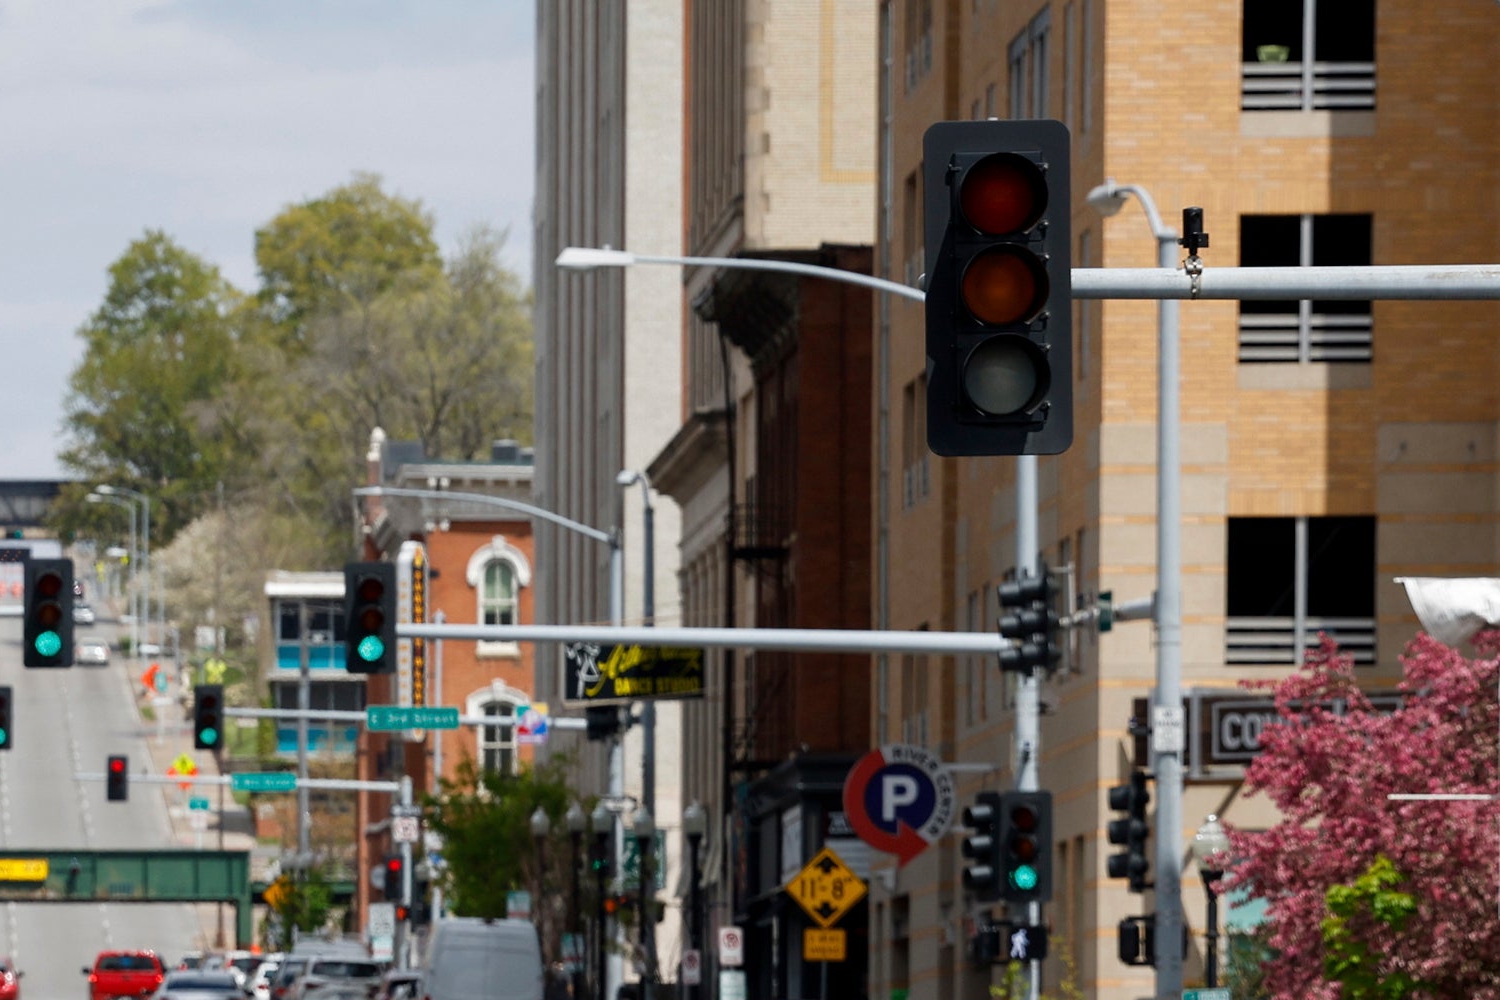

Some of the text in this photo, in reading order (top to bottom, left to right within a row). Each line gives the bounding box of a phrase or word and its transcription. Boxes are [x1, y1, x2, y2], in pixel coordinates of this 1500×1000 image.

[881, 774, 919, 822] P
[892, 746, 952, 835] RIVER CENTER
